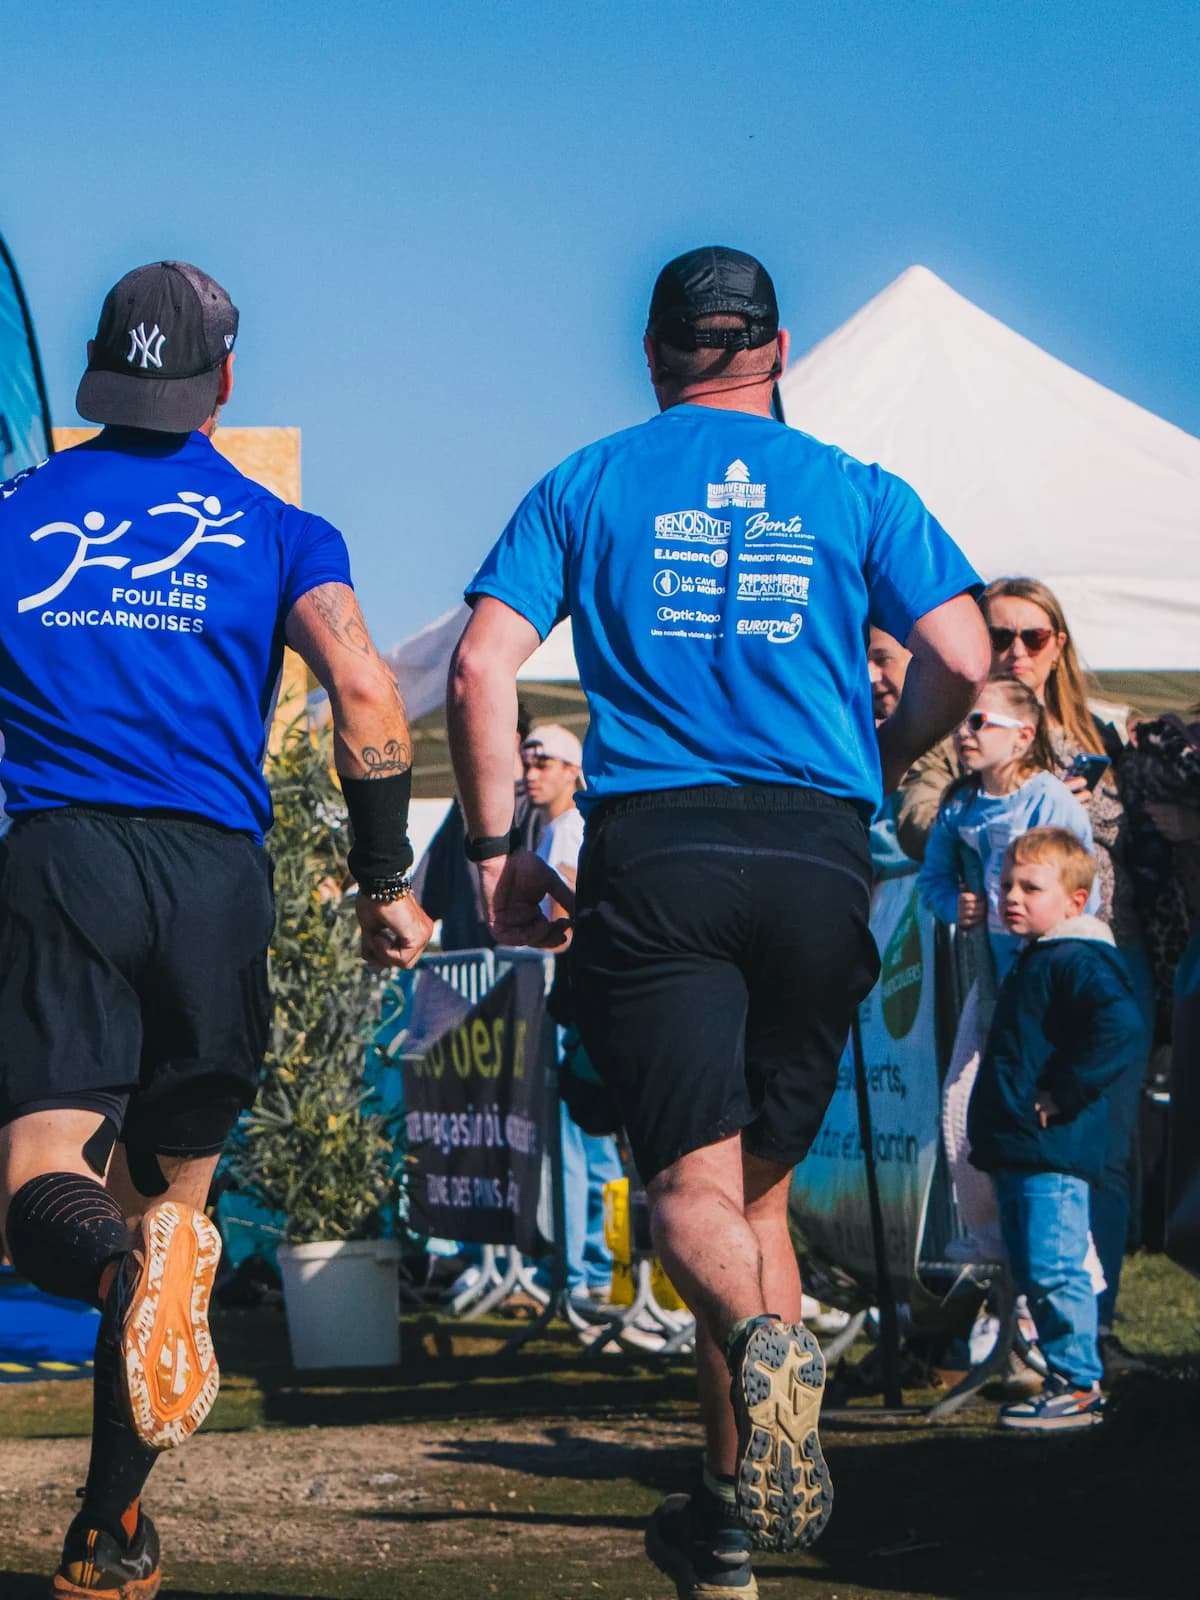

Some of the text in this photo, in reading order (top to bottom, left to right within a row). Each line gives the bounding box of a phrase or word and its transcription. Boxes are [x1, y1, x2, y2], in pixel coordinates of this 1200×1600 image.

[744, 511, 802, 540] Bonte
[654, 548, 710, 564] E.Leclerc
[171, 570, 208, 590] LES
[681, 576, 717, 587] LA CAVE
[681, 584, 695, 592] DU
[738, 573, 810, 587] IMPRIMERIE
[737, 583, 808, 598] ATLANTIQUE
[112, 587, 207, 611] FOULÉES
[41, 609, 204, 634] CONCARNOISES
[657, 607, 695, 623] Optic
[736, 619, 796, 635] EUROTYRE
